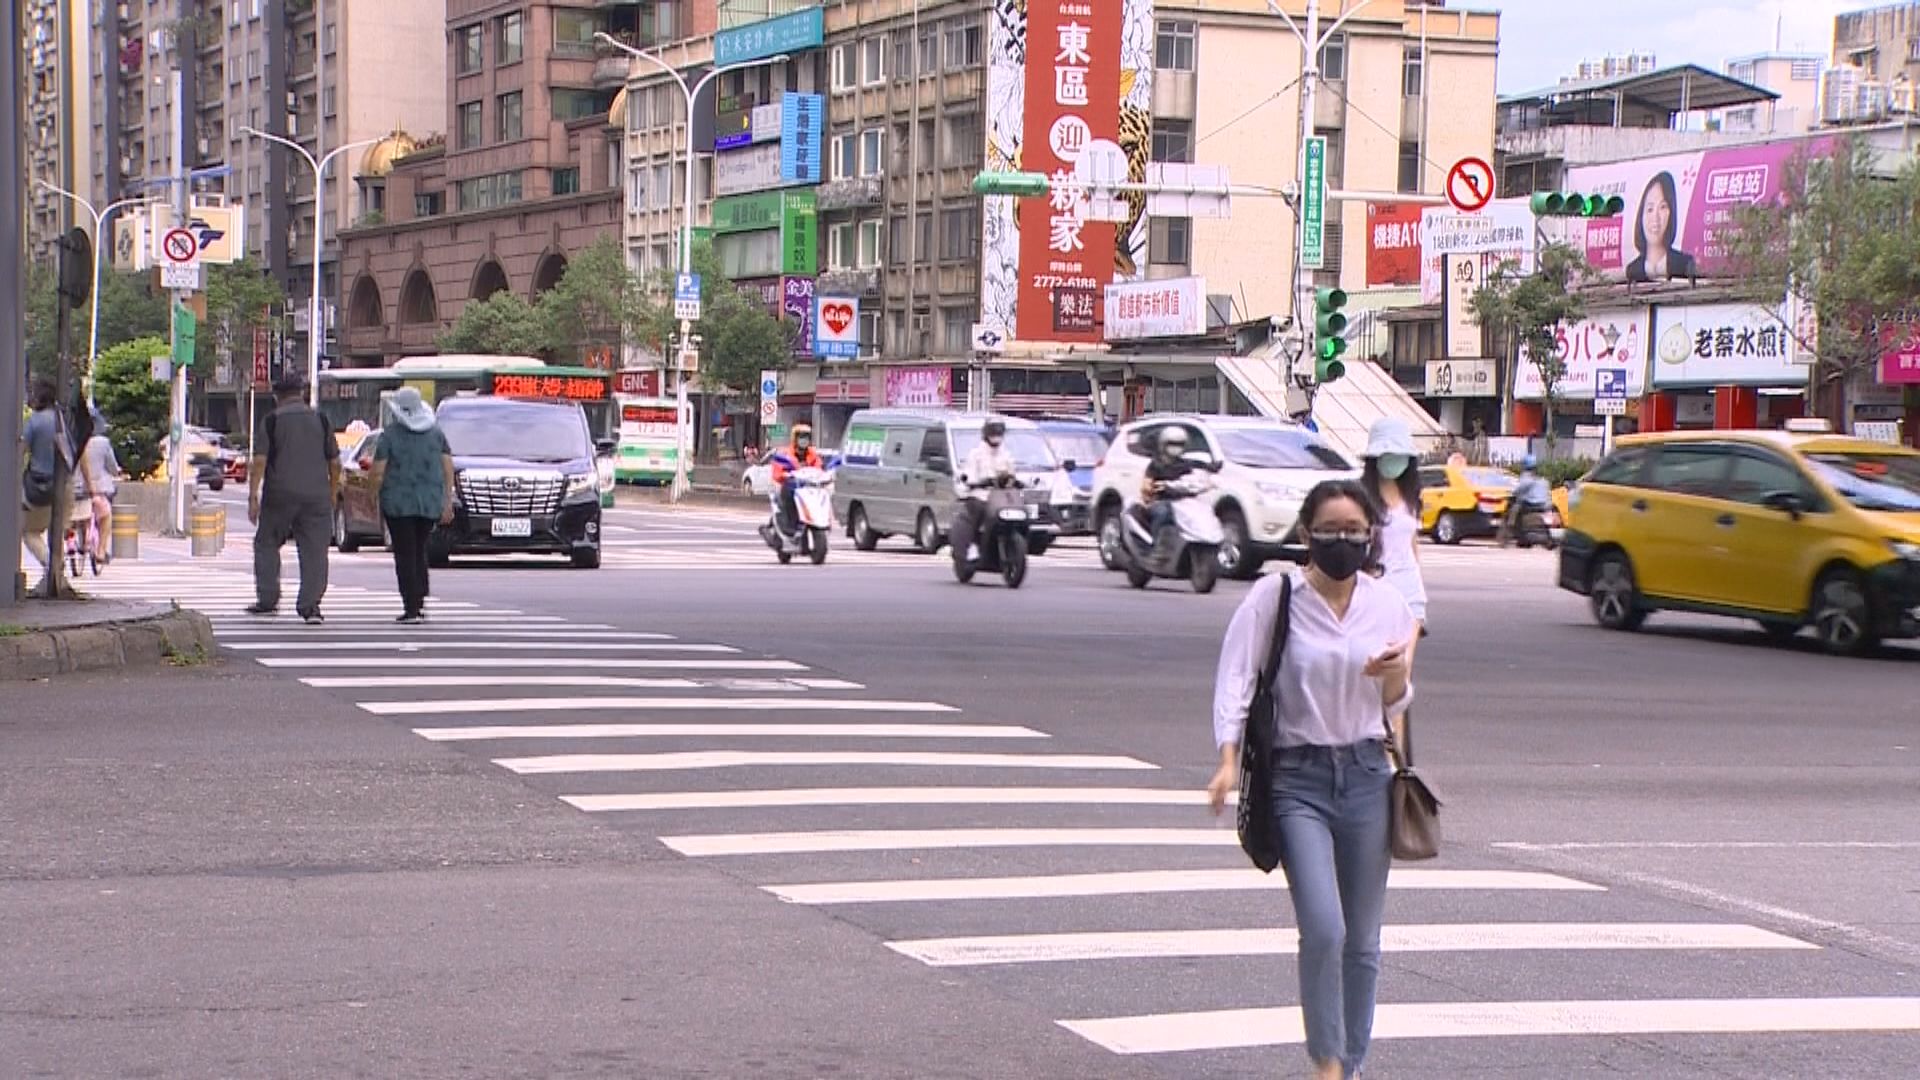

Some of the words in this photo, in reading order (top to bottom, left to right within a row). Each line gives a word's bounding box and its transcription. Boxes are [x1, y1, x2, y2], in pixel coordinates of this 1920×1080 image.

[1712, 171, 1761, 197] 聯絡站
[679, 275, 692, 291] P
[1060, 292, 1093, 316] 樂法
[622, 374, 648, 390] GNC
[1598, 372, 1614, 391] P
